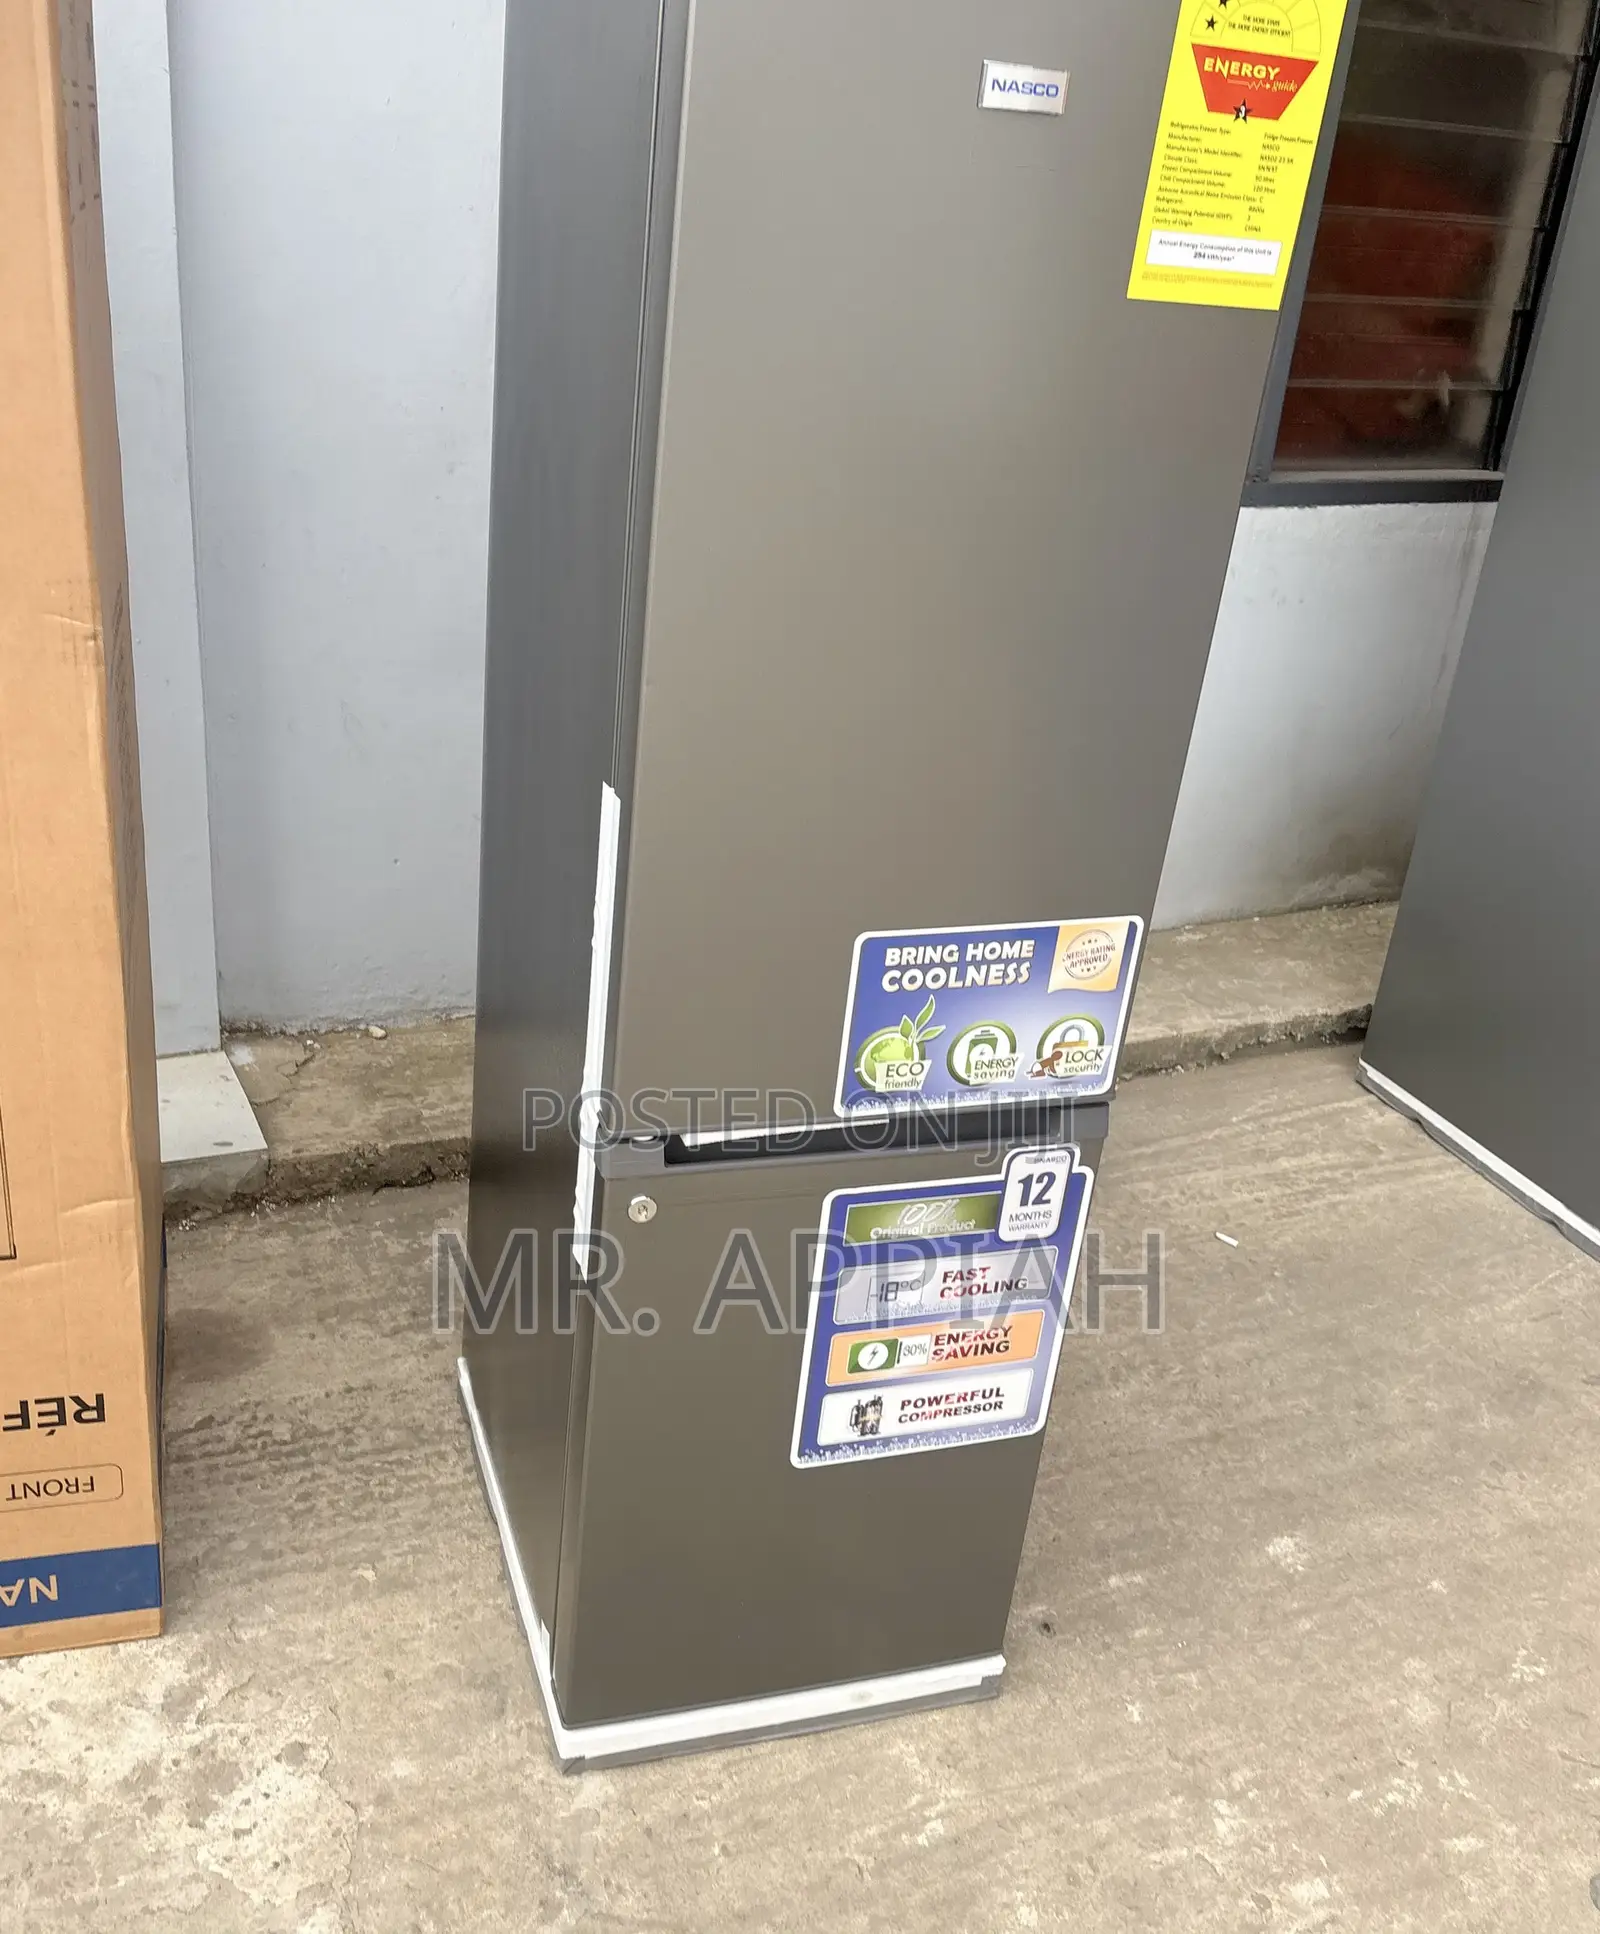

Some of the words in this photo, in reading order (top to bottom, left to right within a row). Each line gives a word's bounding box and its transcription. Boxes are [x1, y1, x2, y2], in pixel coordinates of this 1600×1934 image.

[1203, 54, 1281, 80] ENERGY
[992, 78, 1060, 98] NASCO
[1271, 79, 1298, 93] guide
[1262, 143, 1280, 152] NASCO
[1158, 238, 1178, 247] Annual
[1179, 240, 1198, 250] Energy
[1200, 243, 1236, 253] Consumption
[884, 944, 960, 966] BRING
[965, 940, 1035, 961] HOME
[1090, 943, 1116, 955] RATING
[1070, 953, 1108, 969] APPROVED
[881, 962, 1031, 992] COOLNESS
[974, 1057, 1019, 1070] ENERGY
[1065, 1049, 1104, 1063] LOCK
[885, 1062, 925, 1078] ECO
[972, 1068, 1016, 1080] saving
[1063, 1062, 1103, 1074] security
[884, 1077, 920, 1090] friendly
[1017, 1171, 1057, 1209] 12
[897, 1198, 960, 1225] 100%
[1008, 1210, 1053, 1223] MONTHS
[870, 1223, 924, 1240] Original
[926, 1218, 977, 1235] Product
[1008, 1220, 1050, 1233] WARRANTY
[942, 1266, 991, 1284] FAST
[939, 1277, 1029, 1300] COOLING
[934, 1326, 1013, 1347] ENERGY
[931, 1340, 1010, 1362] SAVING
[900, 1387, 1005, 1411] POWERFUL
[898, 1401, 1004, 1424] COMPRESSOR
[6, 1475, 95, 1501] FRONT
